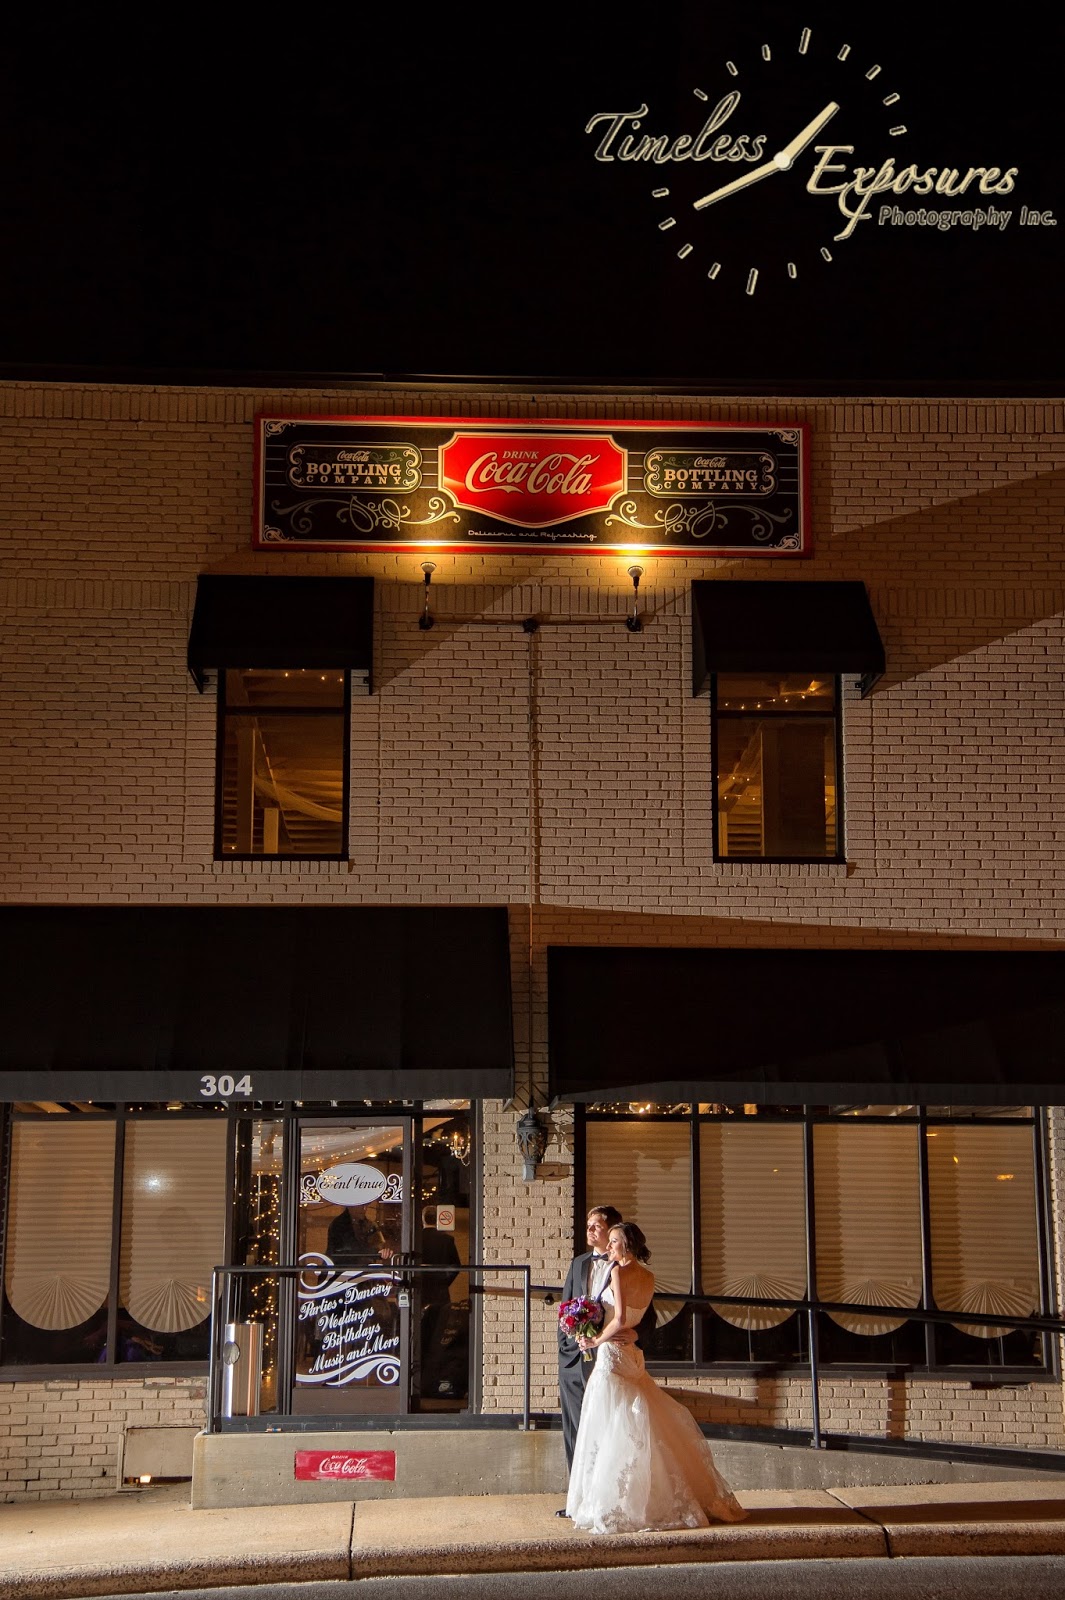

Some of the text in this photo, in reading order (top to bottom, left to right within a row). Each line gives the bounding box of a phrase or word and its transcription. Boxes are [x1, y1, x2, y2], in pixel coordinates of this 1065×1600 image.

[501, 450, 539, 460] DRINK
[306, 462, 402, 477] BOTTLING
[663, 468, 759, 482] BOTTLING
[306, 475, 402, 485] COMPANY
[663, 481, 758, 490] COMPANY
[200, 1075, 253, 1097] 304
[320, 1174, 384, 1190] Eent Venue
[298, 1282, 394, 1321] Parties Dancing
[317, 1305, 375, 1333] Weddings
[321, 1322, 381, 1350] Birthdays
[308, 1336, 400, 1374] Music and More
